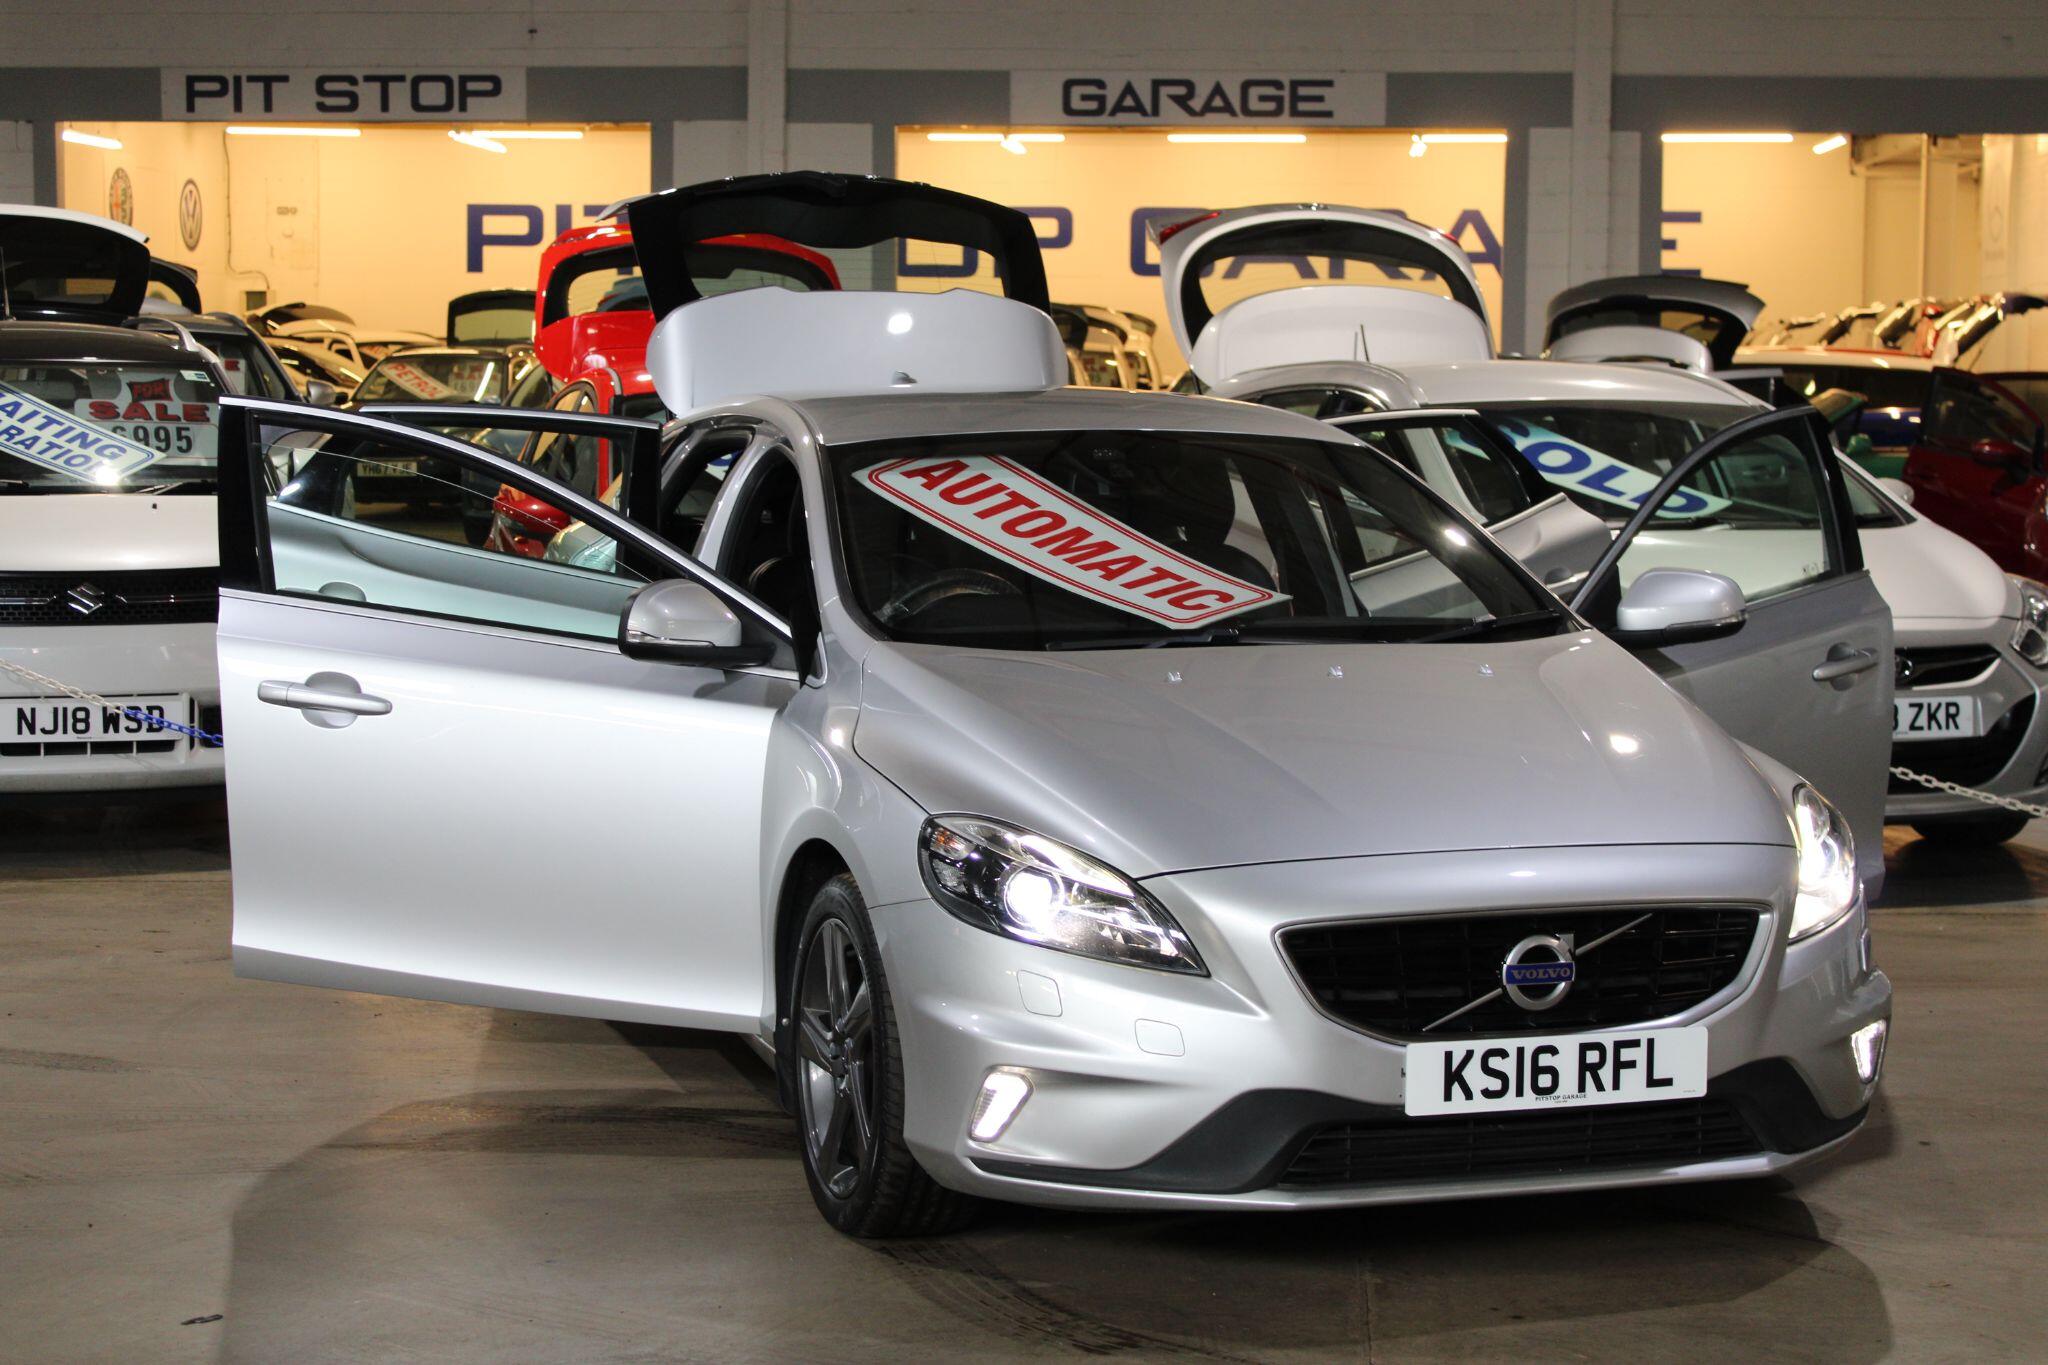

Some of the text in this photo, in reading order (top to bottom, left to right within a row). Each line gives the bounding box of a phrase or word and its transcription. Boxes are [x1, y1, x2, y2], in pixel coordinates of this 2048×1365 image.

[186, 75, 502, 113] PIT STOP
[1062, 78, 1334, 118] GARAGE
[0, 392, 128, 461] AITING
[88, 401, 210, 423] SALE
[0, 420, 105, 473] RATIO
[899, 460, 1236, 612] AUTOMATIC
[16, 704, 165, 735] NJ18 WSD
[1908, 702, 1961, 731] ZKR
[1511, 967, 1571, 980] VOLVO
[1443, 1037, 1674, 1102] KS16 RFL
